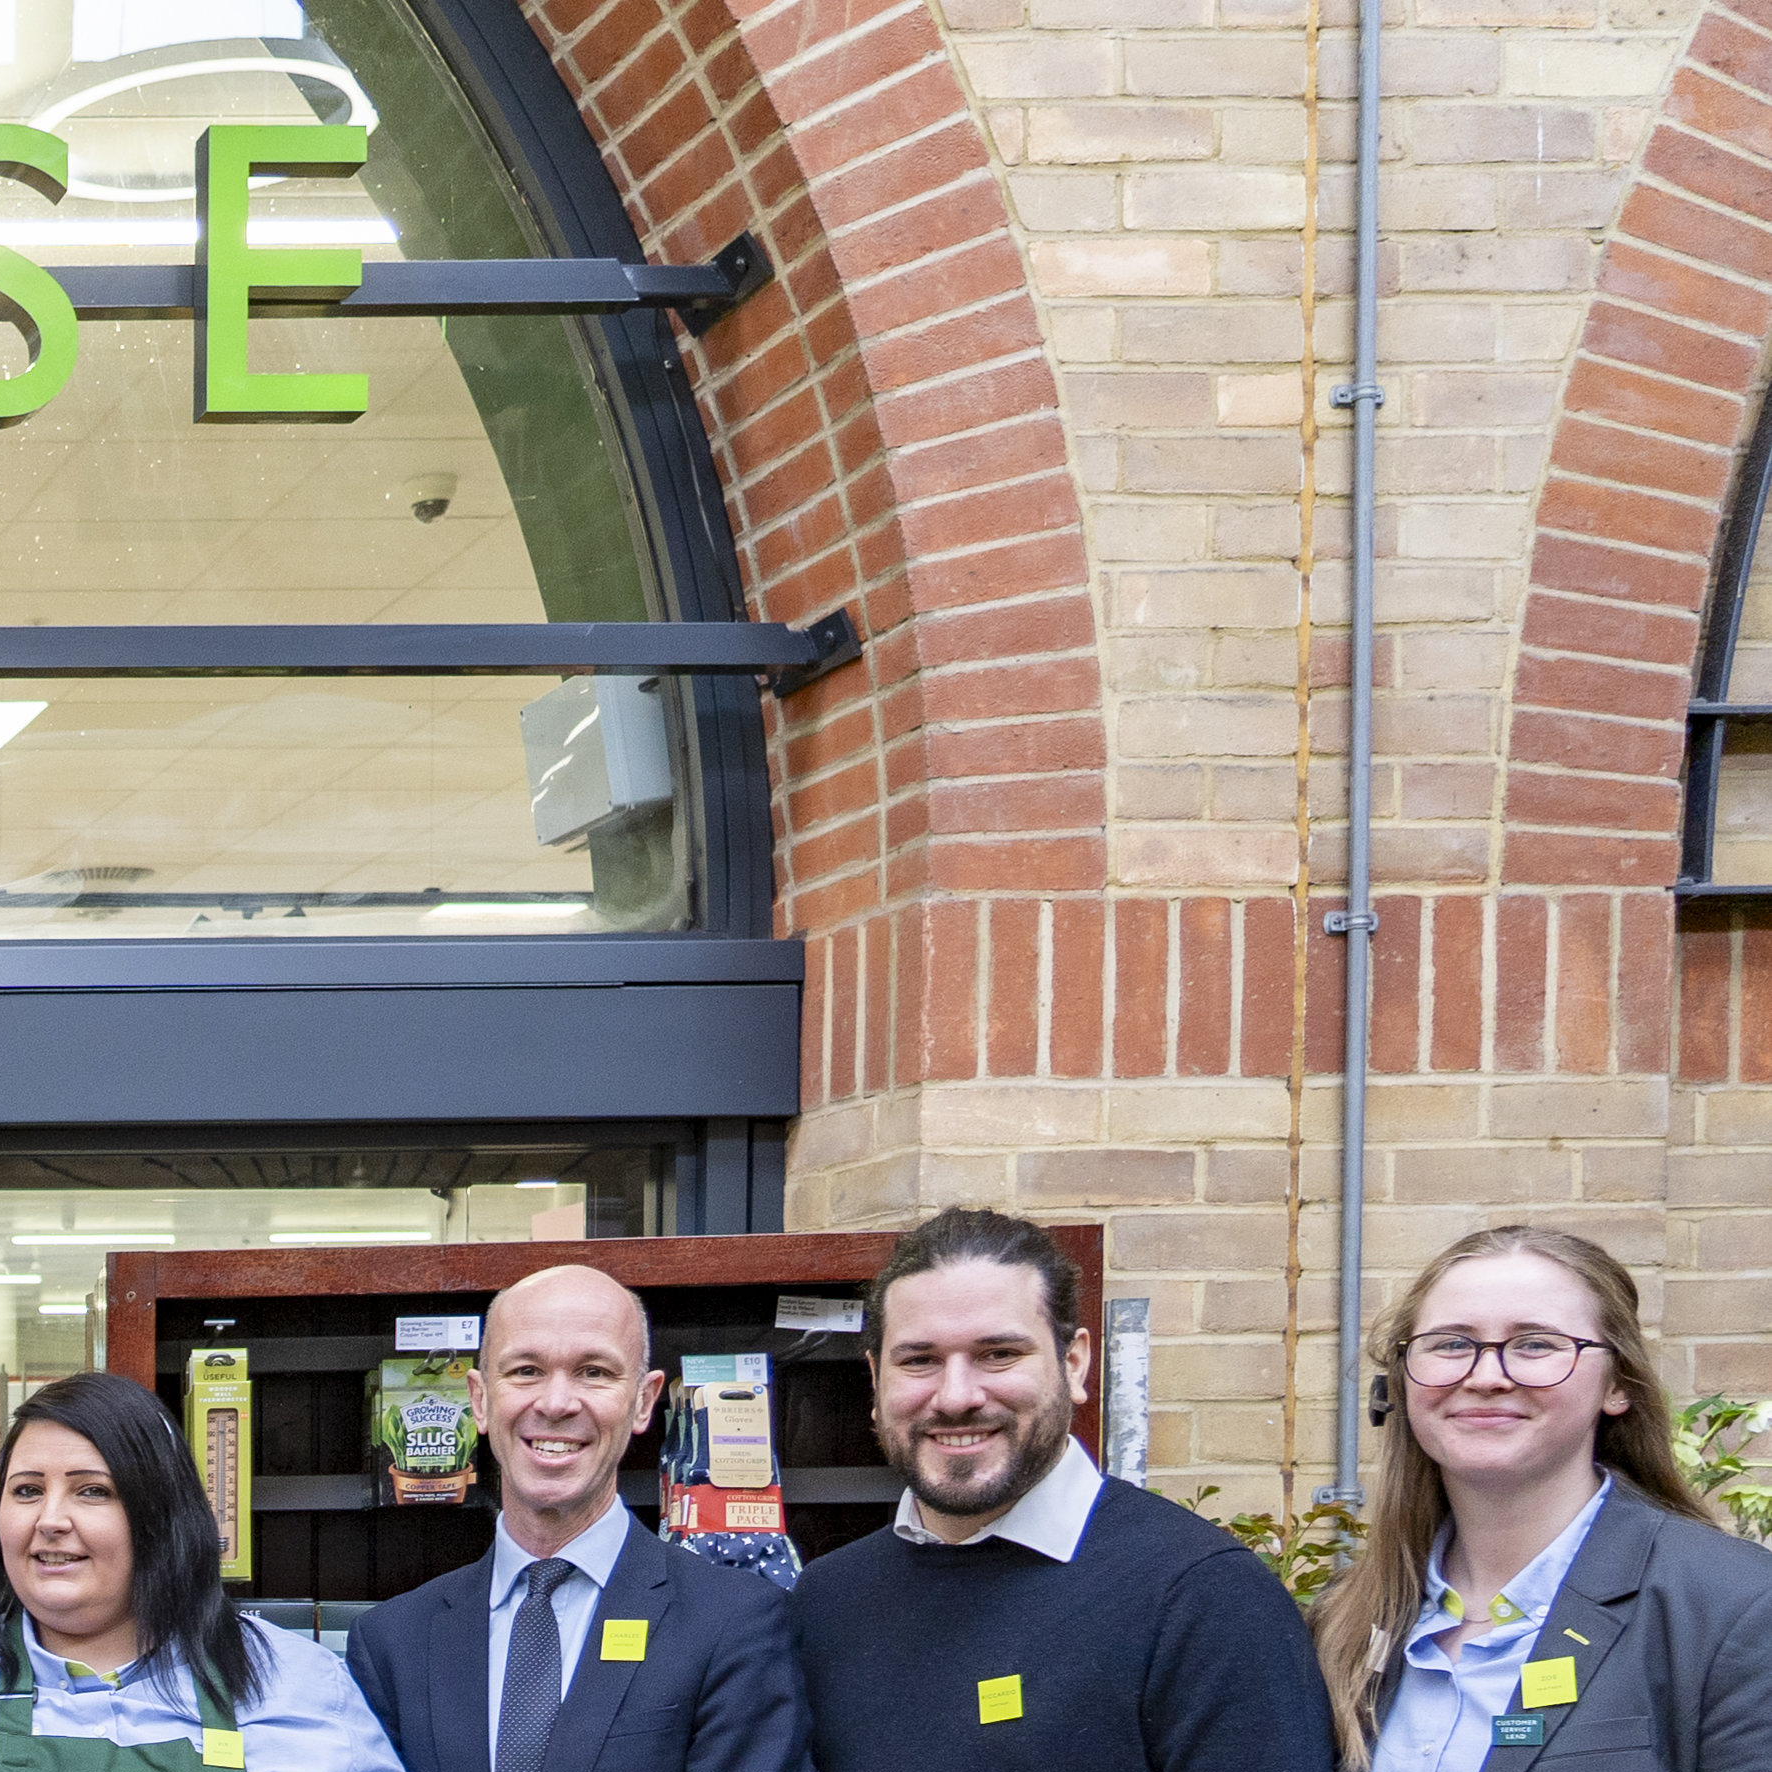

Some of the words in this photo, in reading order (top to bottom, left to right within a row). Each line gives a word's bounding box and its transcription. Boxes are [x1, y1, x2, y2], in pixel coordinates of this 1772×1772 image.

[843, 1302, 855, 1311] £4
[461, 1320, 473, 1329] £7
[744, 1357, 761, 1366] £10
[203, 1373, 237, 1381] USEFUL
[407, 1406, 456, 1417] GROWING
[410, 1413, 453, 1425] SUCCESS
[724, 1415, 753, 1424] Gloves
[407, 1431, 456, 1447] SLUG
[407, 1446, 456, 1456] BARRIER
[730, 1505, 777, 1515] TRIPLE
[736, 1515, 769, 1524] PACK
